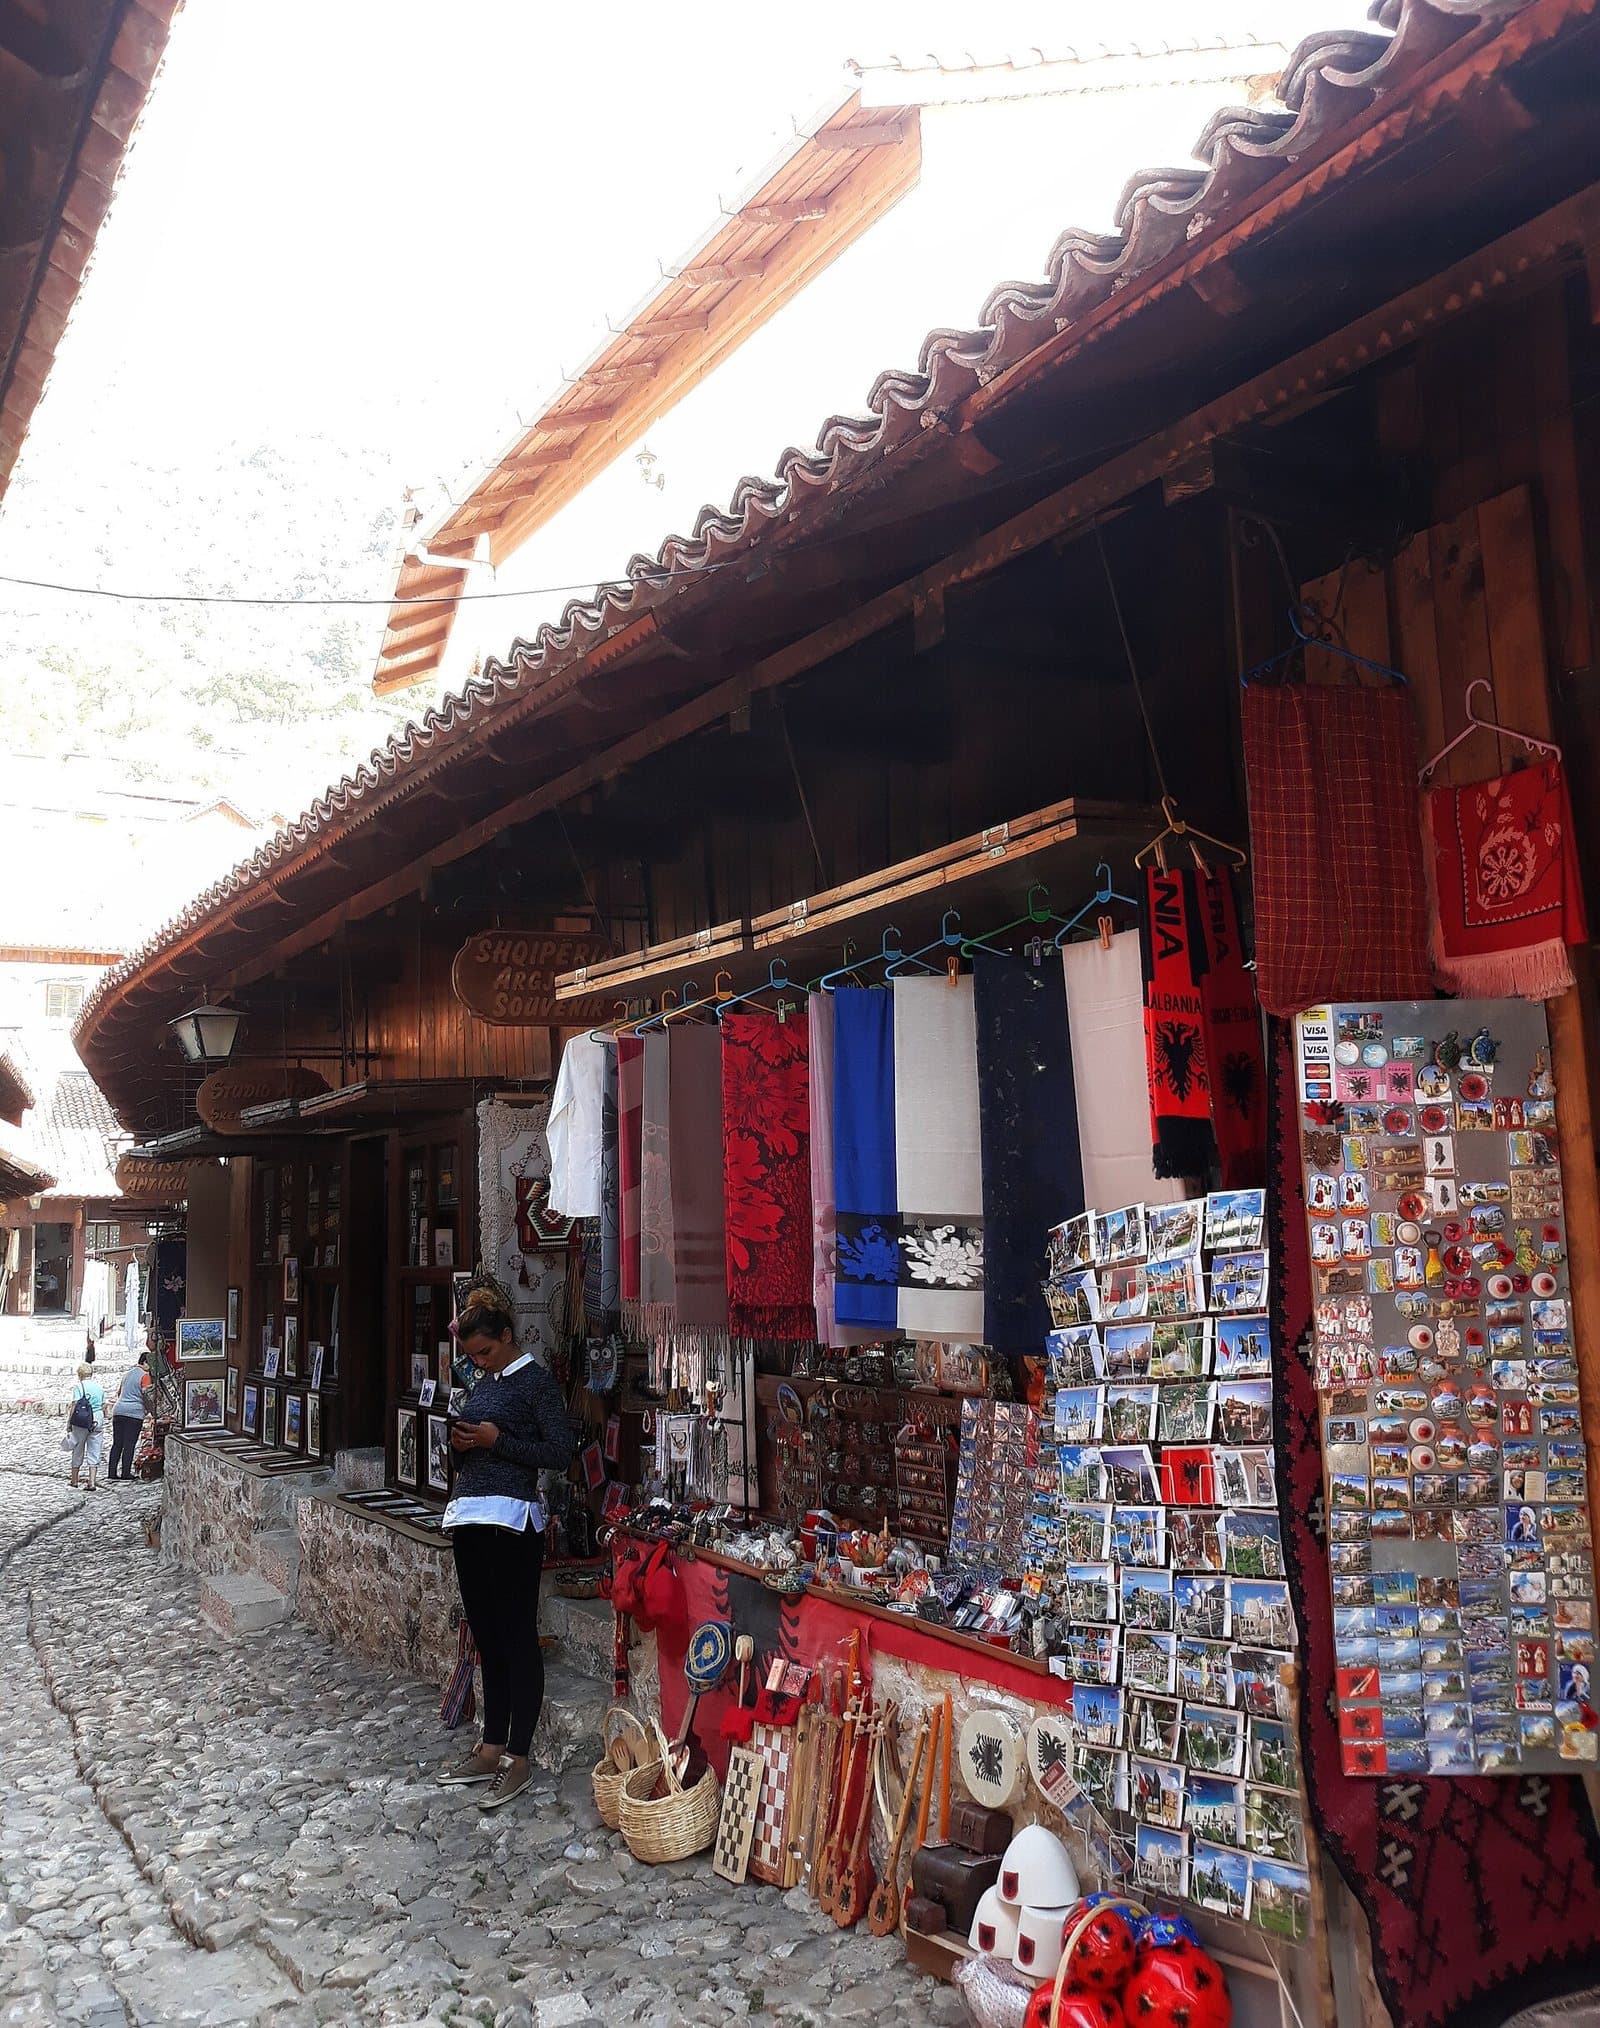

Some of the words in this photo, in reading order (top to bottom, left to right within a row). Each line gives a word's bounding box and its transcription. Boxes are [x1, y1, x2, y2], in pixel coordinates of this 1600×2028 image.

[494, 966, 555, 992] ARGJ
[492, 991, 603, 1018] SOUVENIR
[1150, 993, 1202, 1015] ALBANIA
[1305, 1026, 1327, 1035] VISA
[1306, 1045, 1329, 1054] VISA
[126, 1176, 187, 1193] ANTIKU
